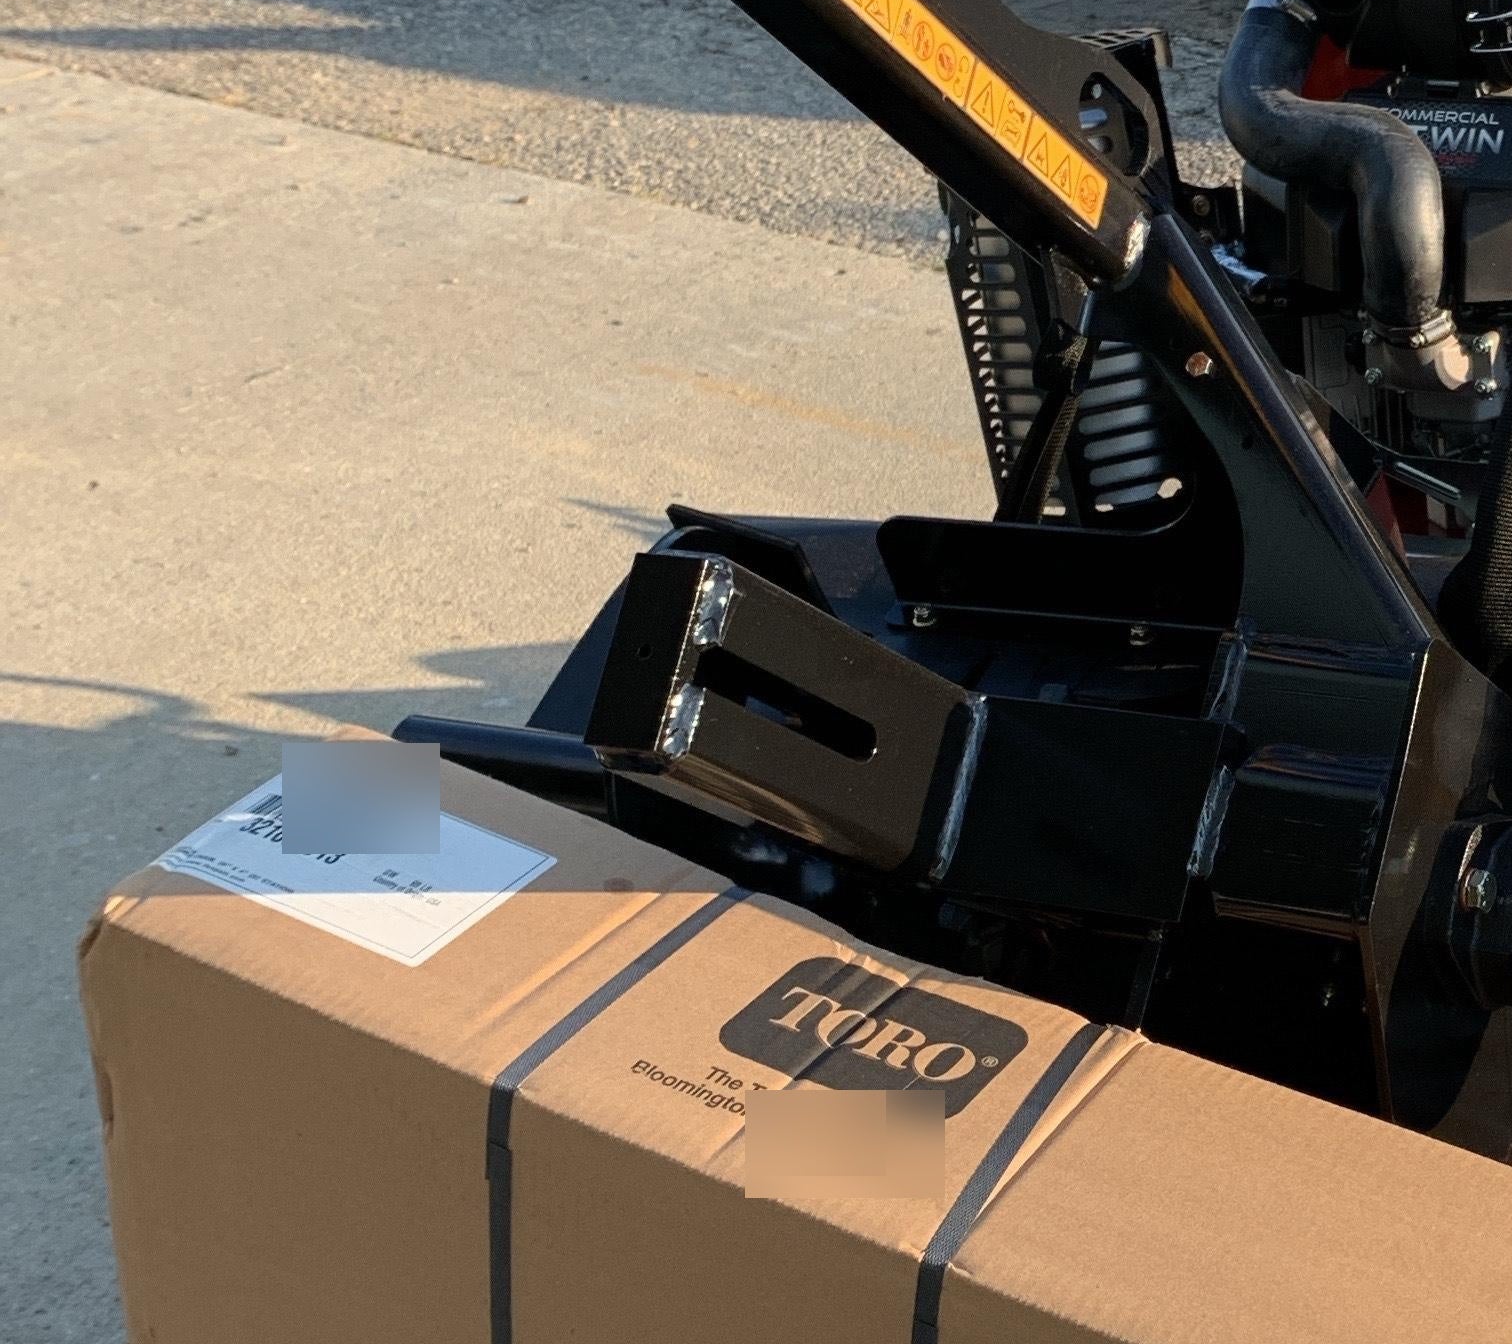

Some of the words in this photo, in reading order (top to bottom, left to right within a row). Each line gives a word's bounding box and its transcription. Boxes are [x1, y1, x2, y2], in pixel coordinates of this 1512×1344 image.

[1383, 107, 1499, 125] OMMERCIAL
[768, 985, 977, 1082] TORO
[704, 1065, 744, 1090] The
